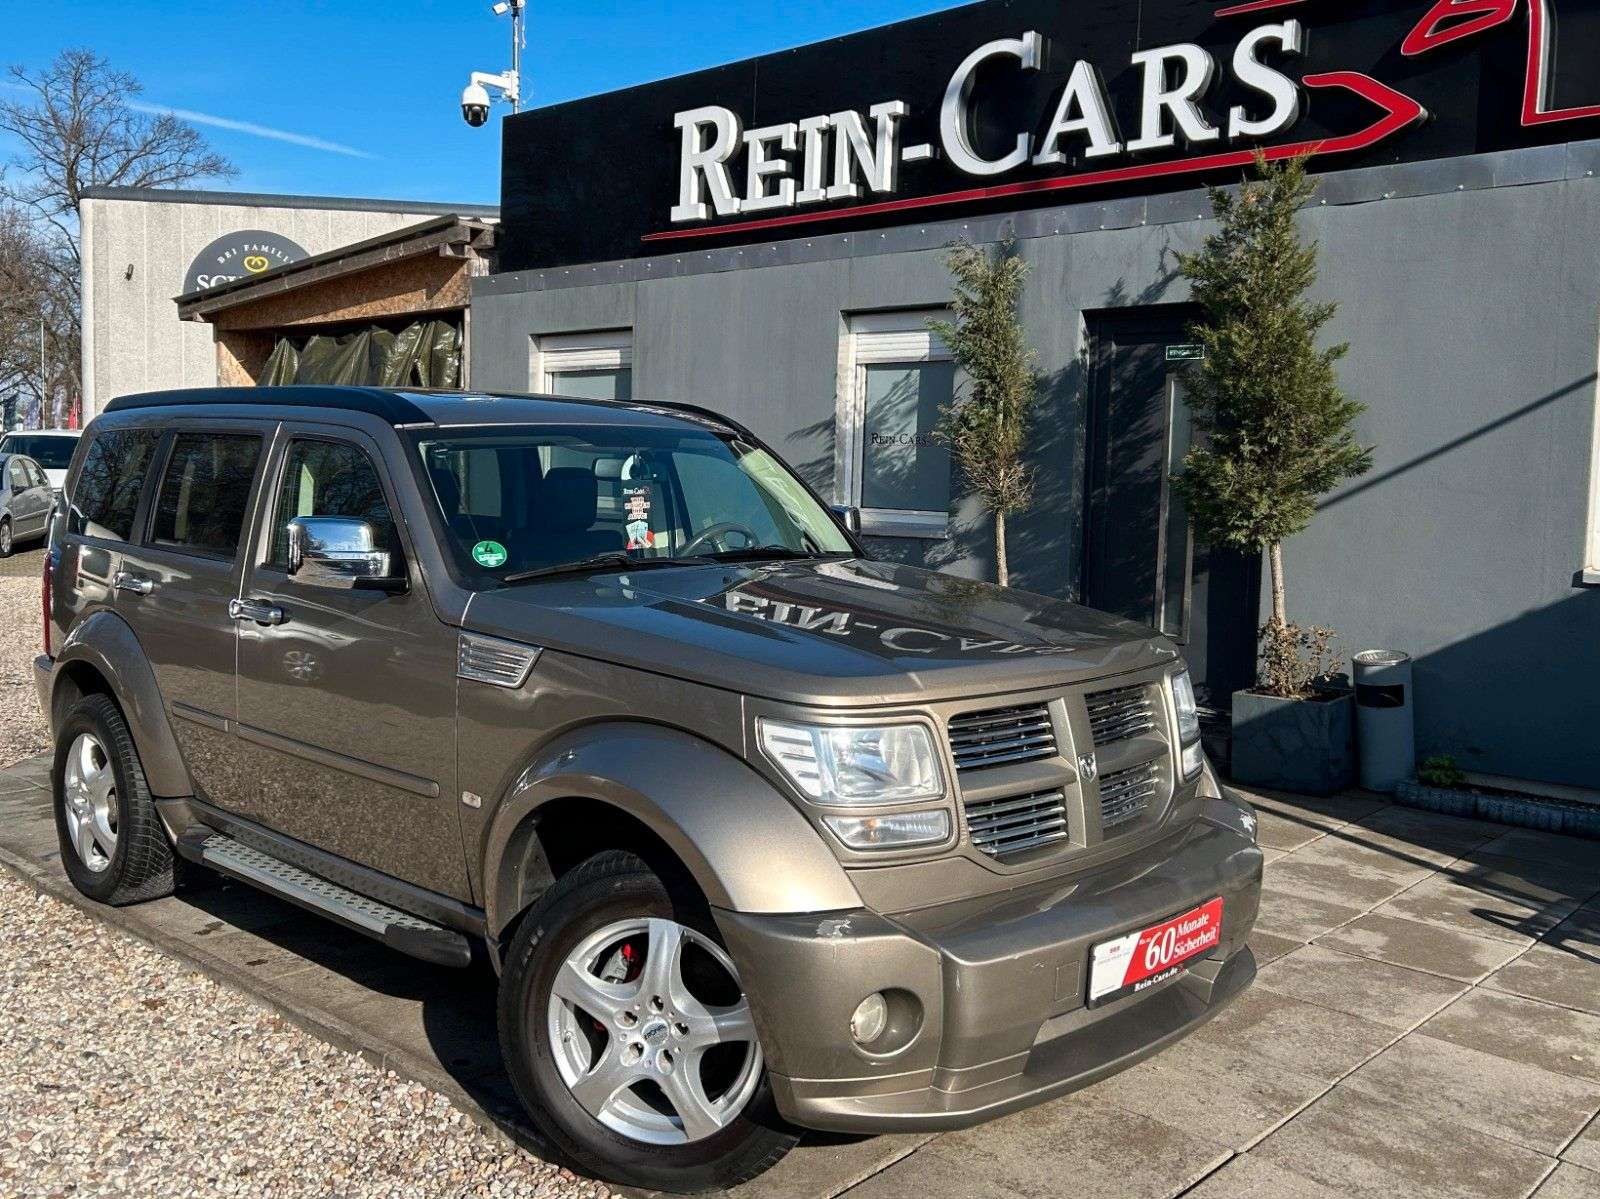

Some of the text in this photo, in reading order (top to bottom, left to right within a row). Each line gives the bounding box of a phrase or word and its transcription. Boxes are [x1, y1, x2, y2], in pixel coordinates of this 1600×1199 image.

[217, 244, 294, 264] BEI FAMILI
[1144, 913, 1210, 970] 60 Monate
[1173, 926, 1217, 958] Sicherheit
